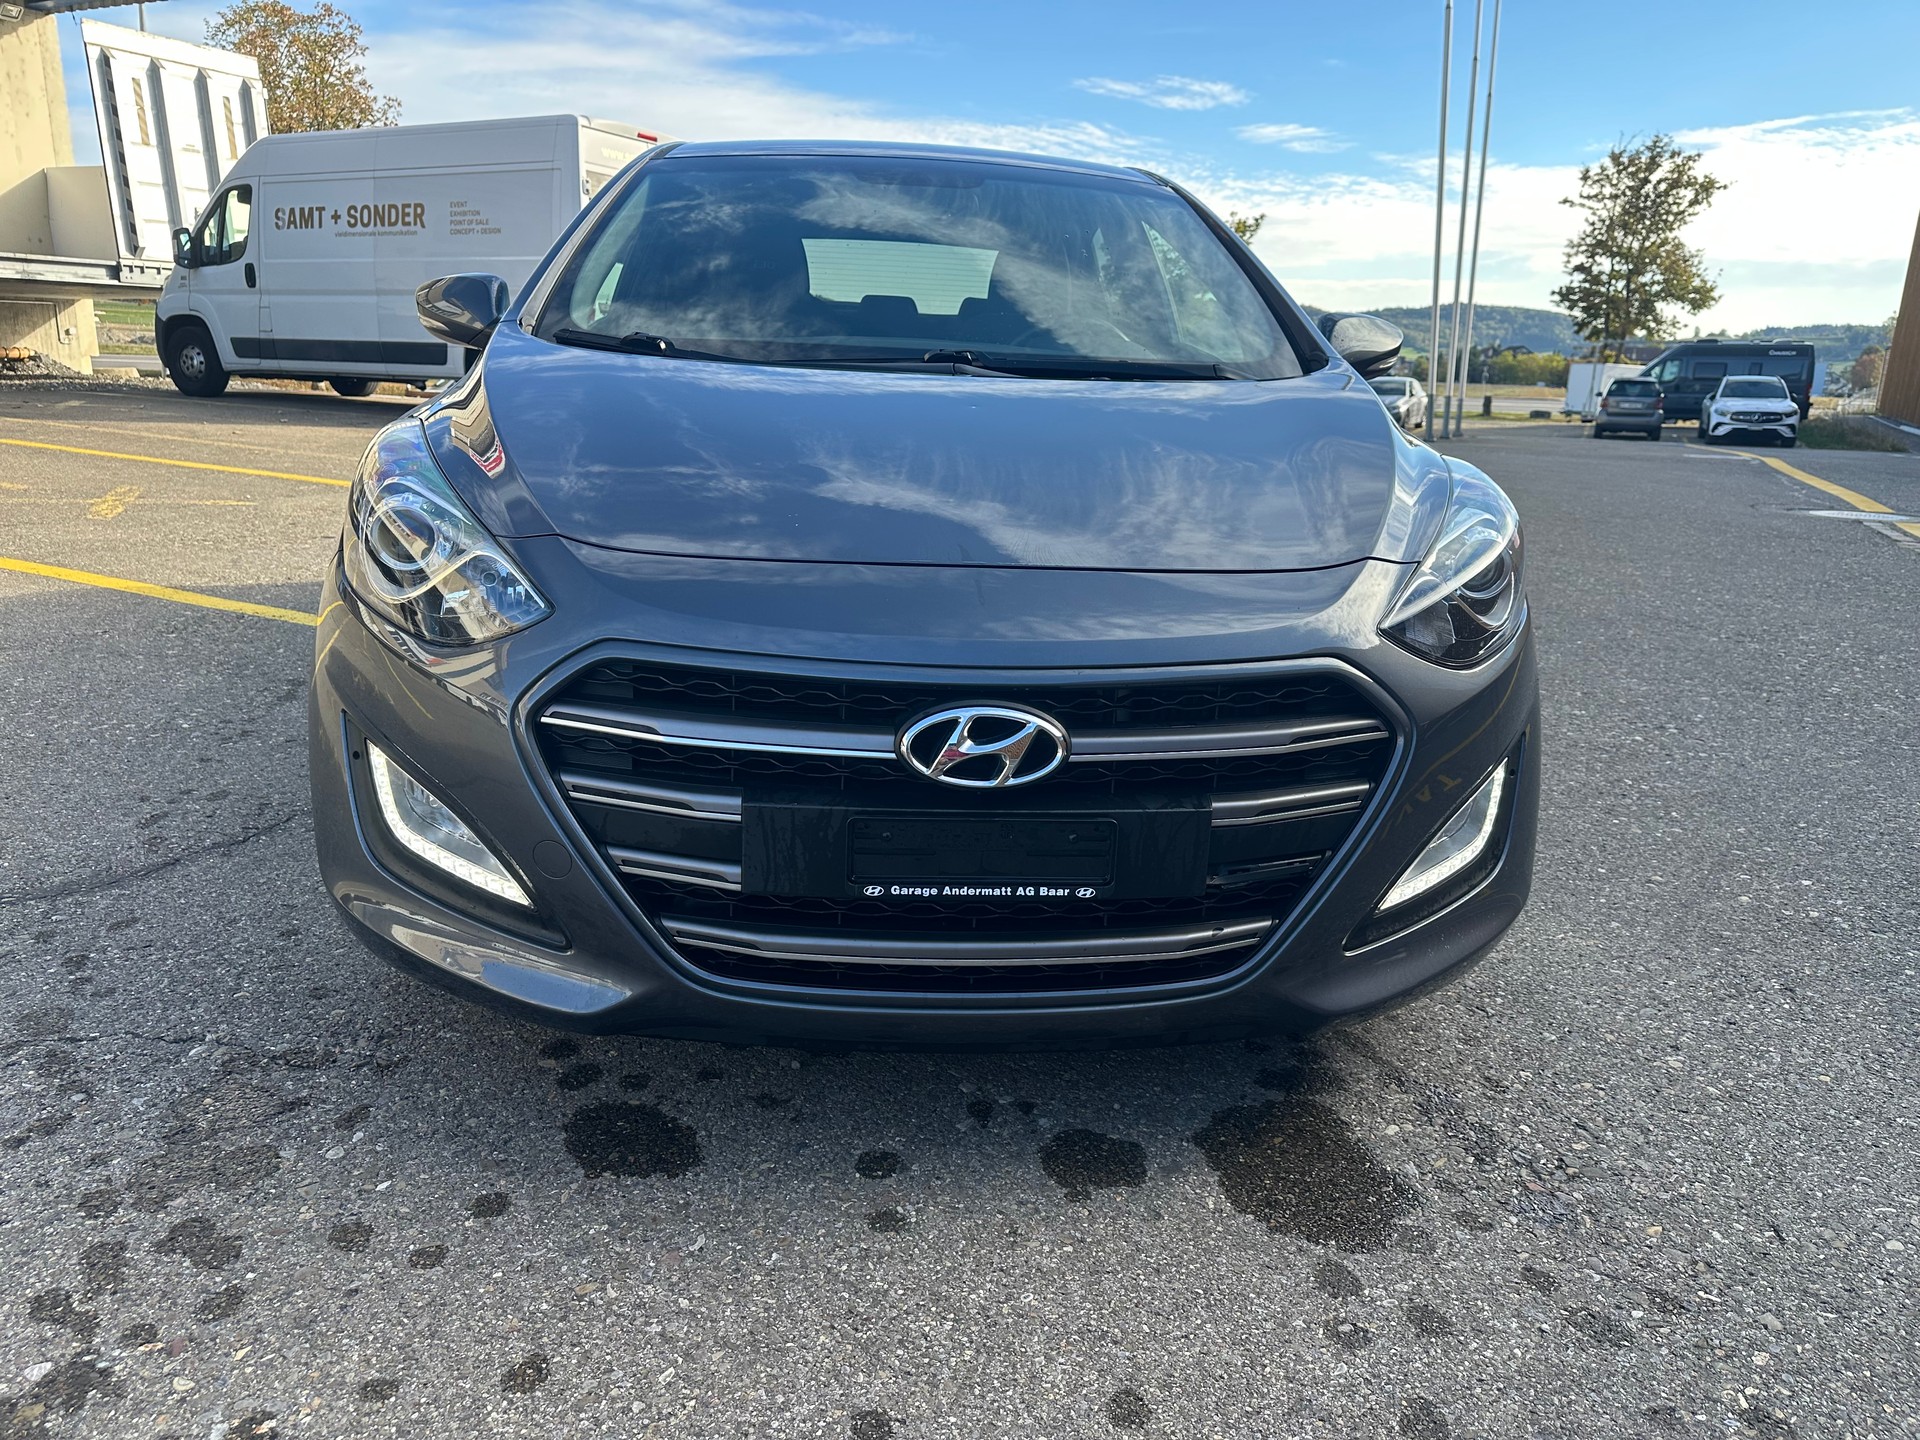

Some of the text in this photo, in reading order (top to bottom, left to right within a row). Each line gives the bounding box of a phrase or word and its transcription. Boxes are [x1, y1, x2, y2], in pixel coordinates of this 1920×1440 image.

[450, 200, 468, 208] EVENT
[274, 203, 426, 231] SAMT + SONDER
[450, 209, 480, 217] EXHIBITION
[377, 229, 418, 237] kommunikation
[890, 885, 1070, 897] Garage Andermatt AG Baar
